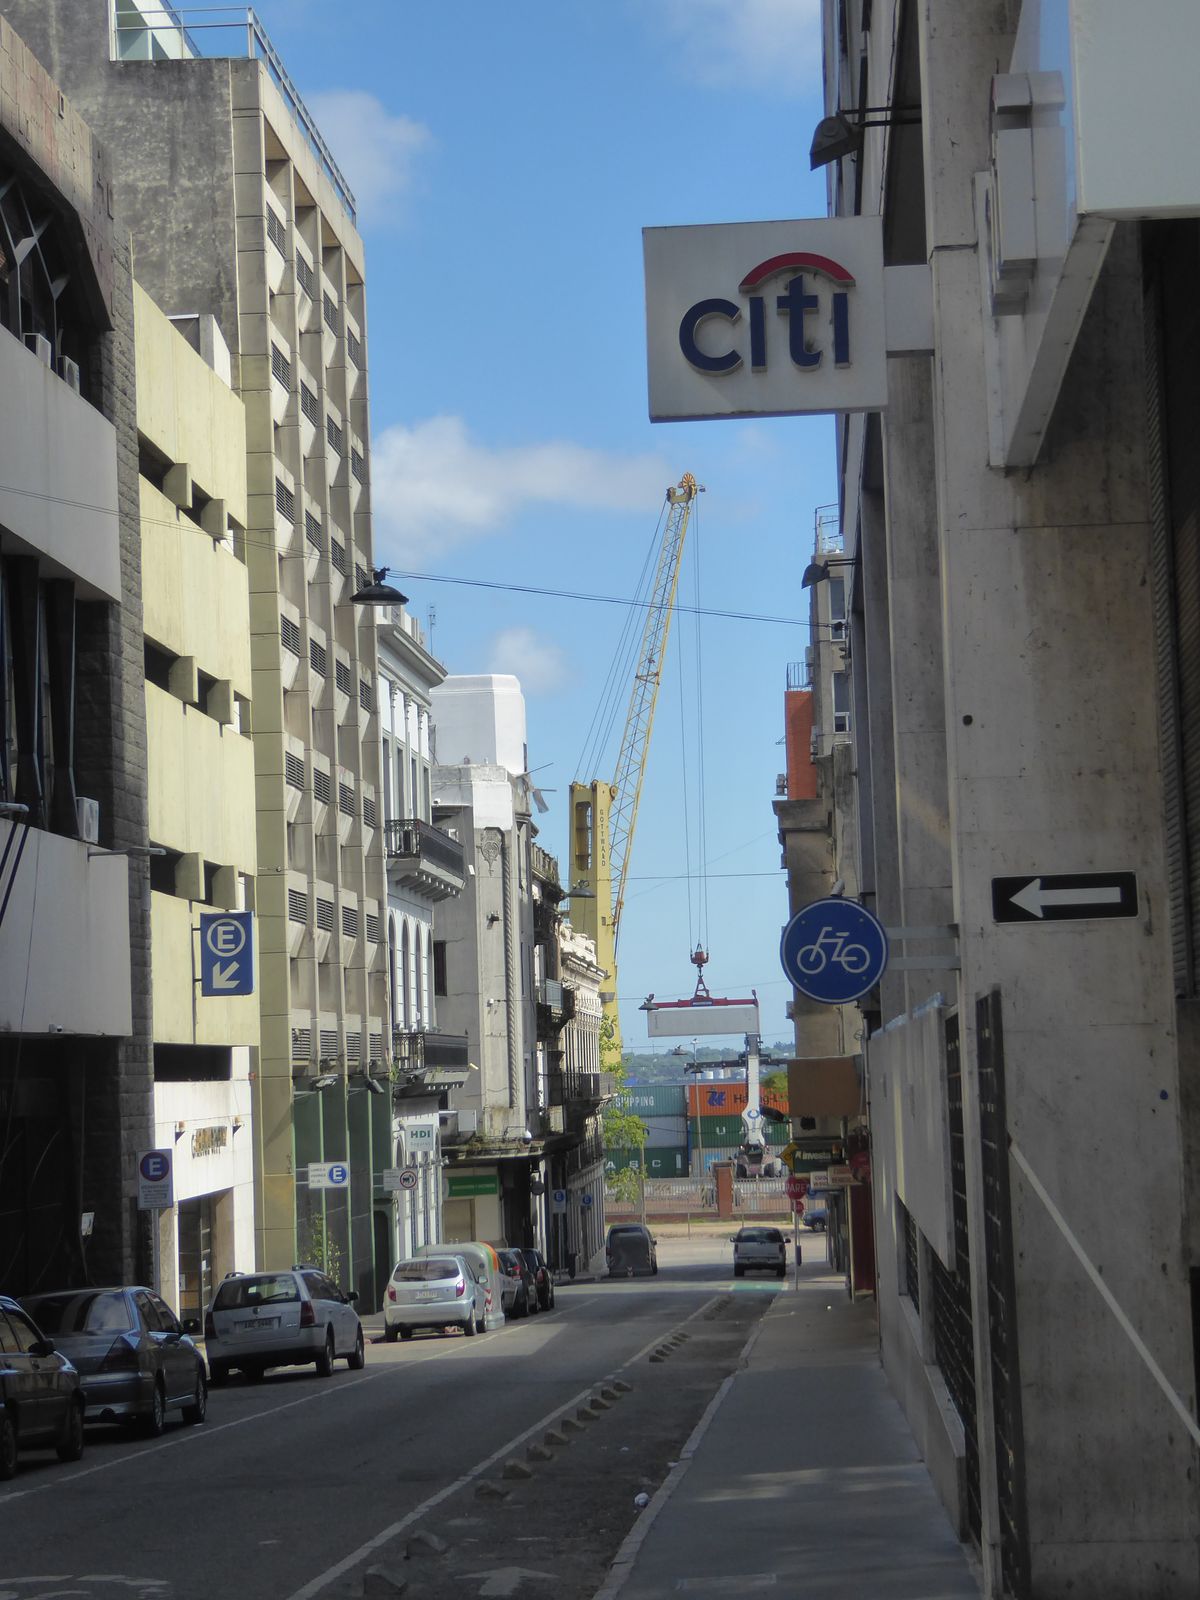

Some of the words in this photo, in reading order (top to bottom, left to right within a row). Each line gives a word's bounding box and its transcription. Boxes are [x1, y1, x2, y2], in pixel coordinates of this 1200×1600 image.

[679, 274, 850, 372] citi
[218, 926, 236, 949] E
[615, 1096, 655, 1108] SHIPPING
[410, 1130, 431, 1139] HDI
[149, 1158, 161, 1175] E
[333, 1168, 342, 1181] E
[785, 1183, 806, 1192] PARE
